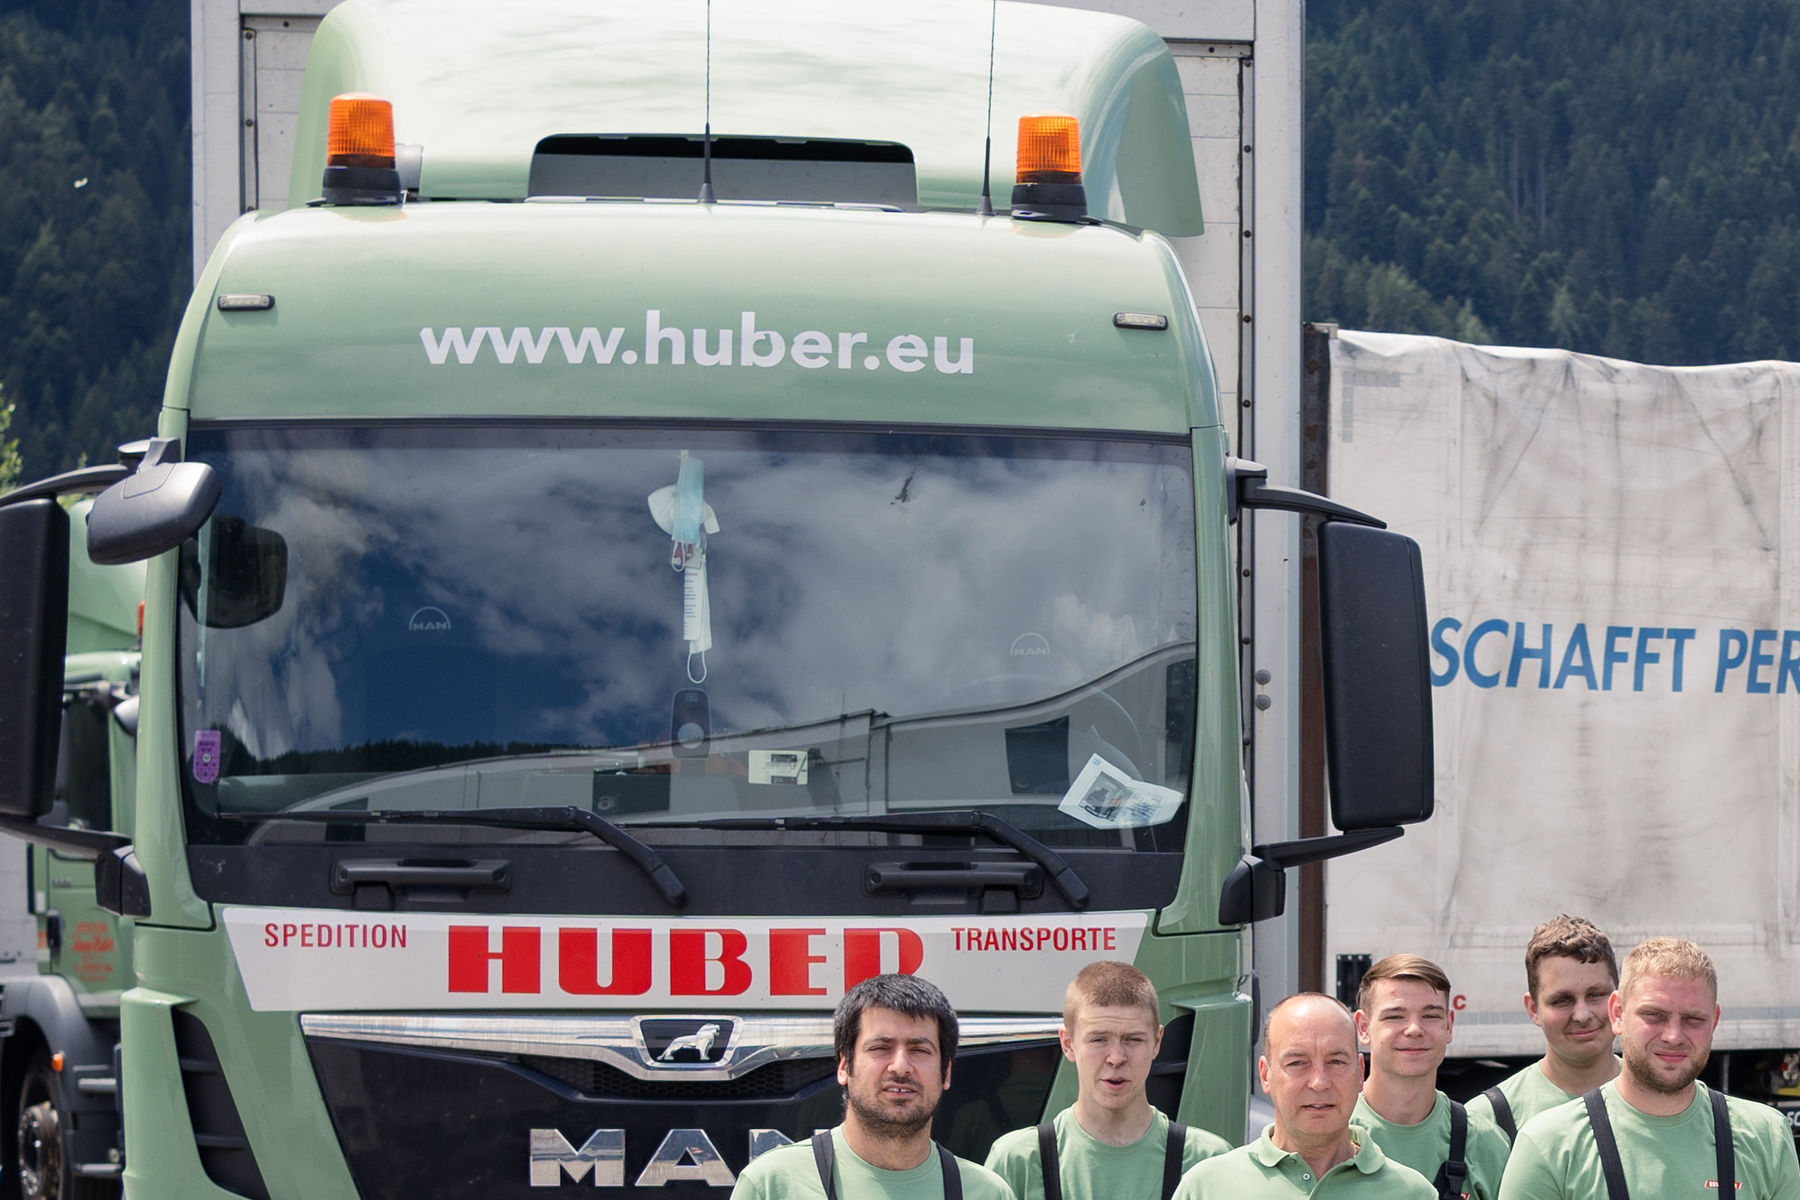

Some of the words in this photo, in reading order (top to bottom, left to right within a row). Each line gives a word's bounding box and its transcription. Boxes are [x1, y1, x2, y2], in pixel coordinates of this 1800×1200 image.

[420, 310, 974, 374] www.huber.eu
[1431, 617, 1696, 693] SCHAFFT
[264, 923, 407, 949] SPEDITION
[951, 927, 1117, 951] TRANSPORTE
[530, 1128, 832, 1187] MA
